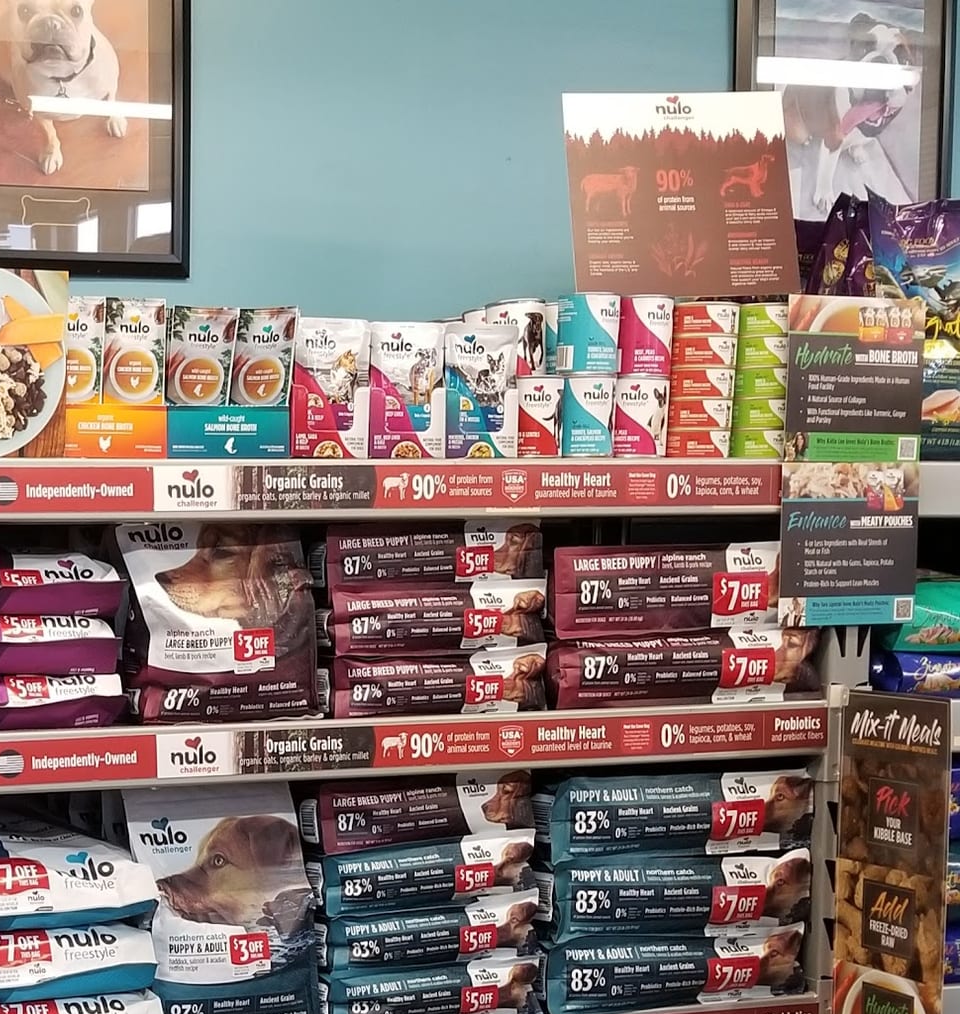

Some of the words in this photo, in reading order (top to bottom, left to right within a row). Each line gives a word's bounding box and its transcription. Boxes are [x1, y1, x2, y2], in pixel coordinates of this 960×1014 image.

[656, 101, 692, 116] nulo
[656, 169, 693, 192] 90%
[666, 196, 681, 205] protein
[682, 195, 694, 203] from
[120, 322, 150, 333] nulo
[796, 342, 853, 369] Hydrate
[869, 350, 890, 363] BONE
[892, 351, 918, 364] BROTH
[524, 390, 551, 402] nulo
[265, 475, 307, 492] Organic
[310, 475, 343, 489] Grains
[412, 475, 446, 500] 90%
[542, 473, 580, 489] Healthy
[583, 473, 611, 486] Heart
[667, 473, 691, 498] 0%
[26, 483, 133, 499] Independently-Owned
[535, 488, 570, 499] guaranteed
[572, 489, 585, 498] level
[587, 489, 593, 498] of
[595, 489, 617, 498] taurine
[177, 500, 217, 508] challenger
[788, 511, 847, 532] Enhance
[862, 516, 883, 526] MEATY
[885, 516, 913, 525] POUCHES
[574, 558, 600, 571] LARGE
[601, 557, 628, 570] BREED
[630, 556, 656, 569] PUPPY
[733, 554, 762, 566] nulo
[580, 580, 612, 604] 87%
[775, 717, 821, 732] Probiotics
[850, 709, 900, 741] Mix-it
[899, 714, 942, 746] Meals
[876, 786, 911, 816] Pick
[874, 827, 895, 843] KIBBLE
[896, 830, 912, 845] BASE
[870, 919, 908, 939] FREEZE-DRIED
[169, 934, 204, 942] northern
[206, 933, 227, 941] catch
[169, 943, 195, 954] PUPPY
[197, 942, 203, 953] &
[205, 941, 227, 952] ADULT
